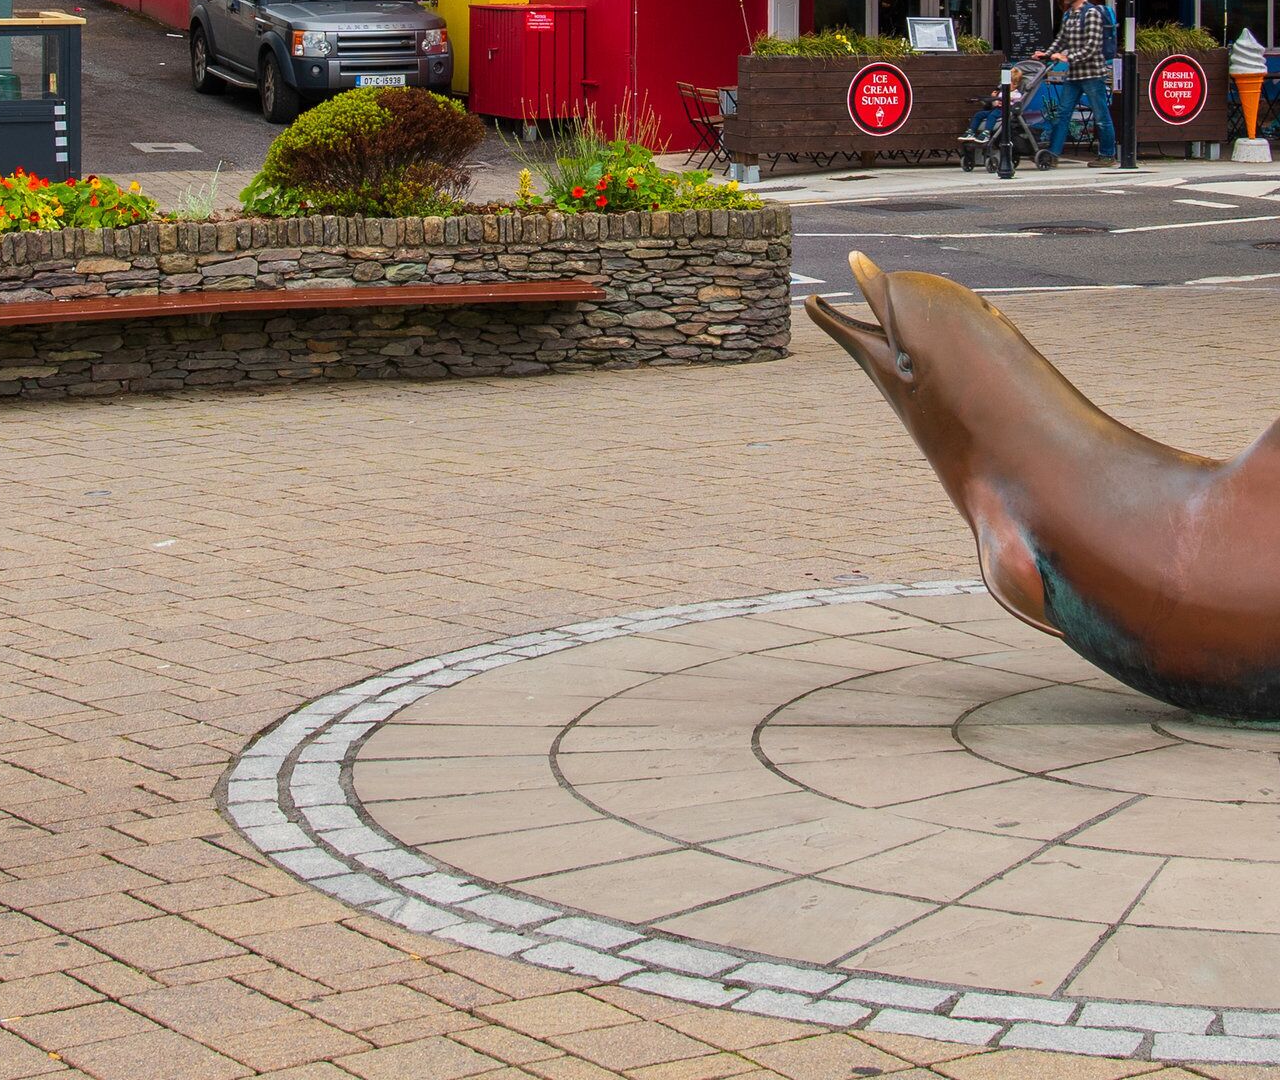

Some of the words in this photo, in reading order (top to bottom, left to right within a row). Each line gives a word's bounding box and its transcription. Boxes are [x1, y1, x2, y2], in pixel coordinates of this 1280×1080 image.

[872, 74, 888, 83] ICE
[1162, 70, 1195, 79] FRESHLY
[863, 84, 897, 94] CREAM
[1163, 80, 1194, 89] BREWED
[1164, 90, 1193, 99] COFFEE
[861, 96, 899, 105] SUNDAE
